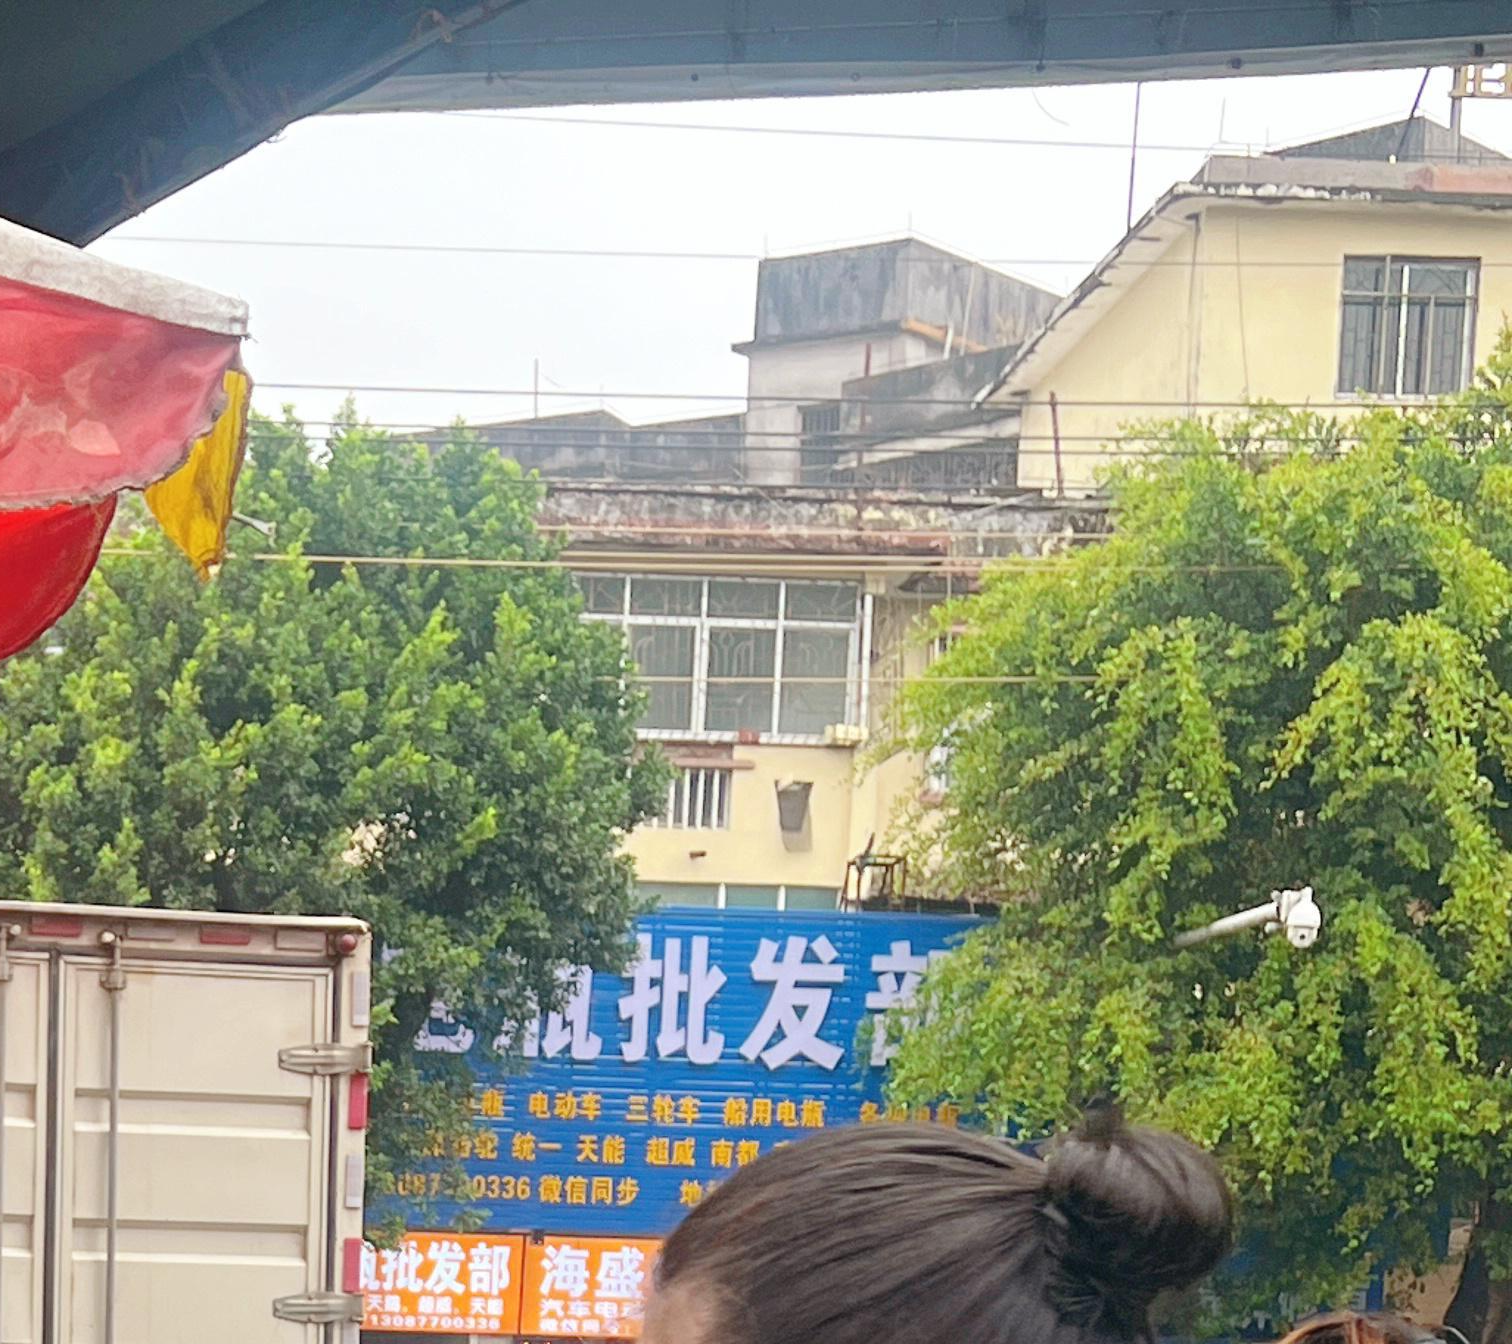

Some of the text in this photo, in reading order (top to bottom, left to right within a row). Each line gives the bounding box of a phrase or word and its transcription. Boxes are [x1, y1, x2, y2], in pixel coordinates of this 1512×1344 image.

[528, 1091, 602, 1120] 电动车
[626, 1094, 702, 1125] 三轮车
[723, 1097, 825, 1128] 船用电瓶
[512, 1131, 563, 1160] 统一
[576, 1135, 626, 1164] 天能
[646, 1137, 696, 1167] 超威
[711, 1139, 762, 1168] 南都
[539, 1175, 640, 1207] 微信同步
[540, 1243, 645, 1300] 海盛
